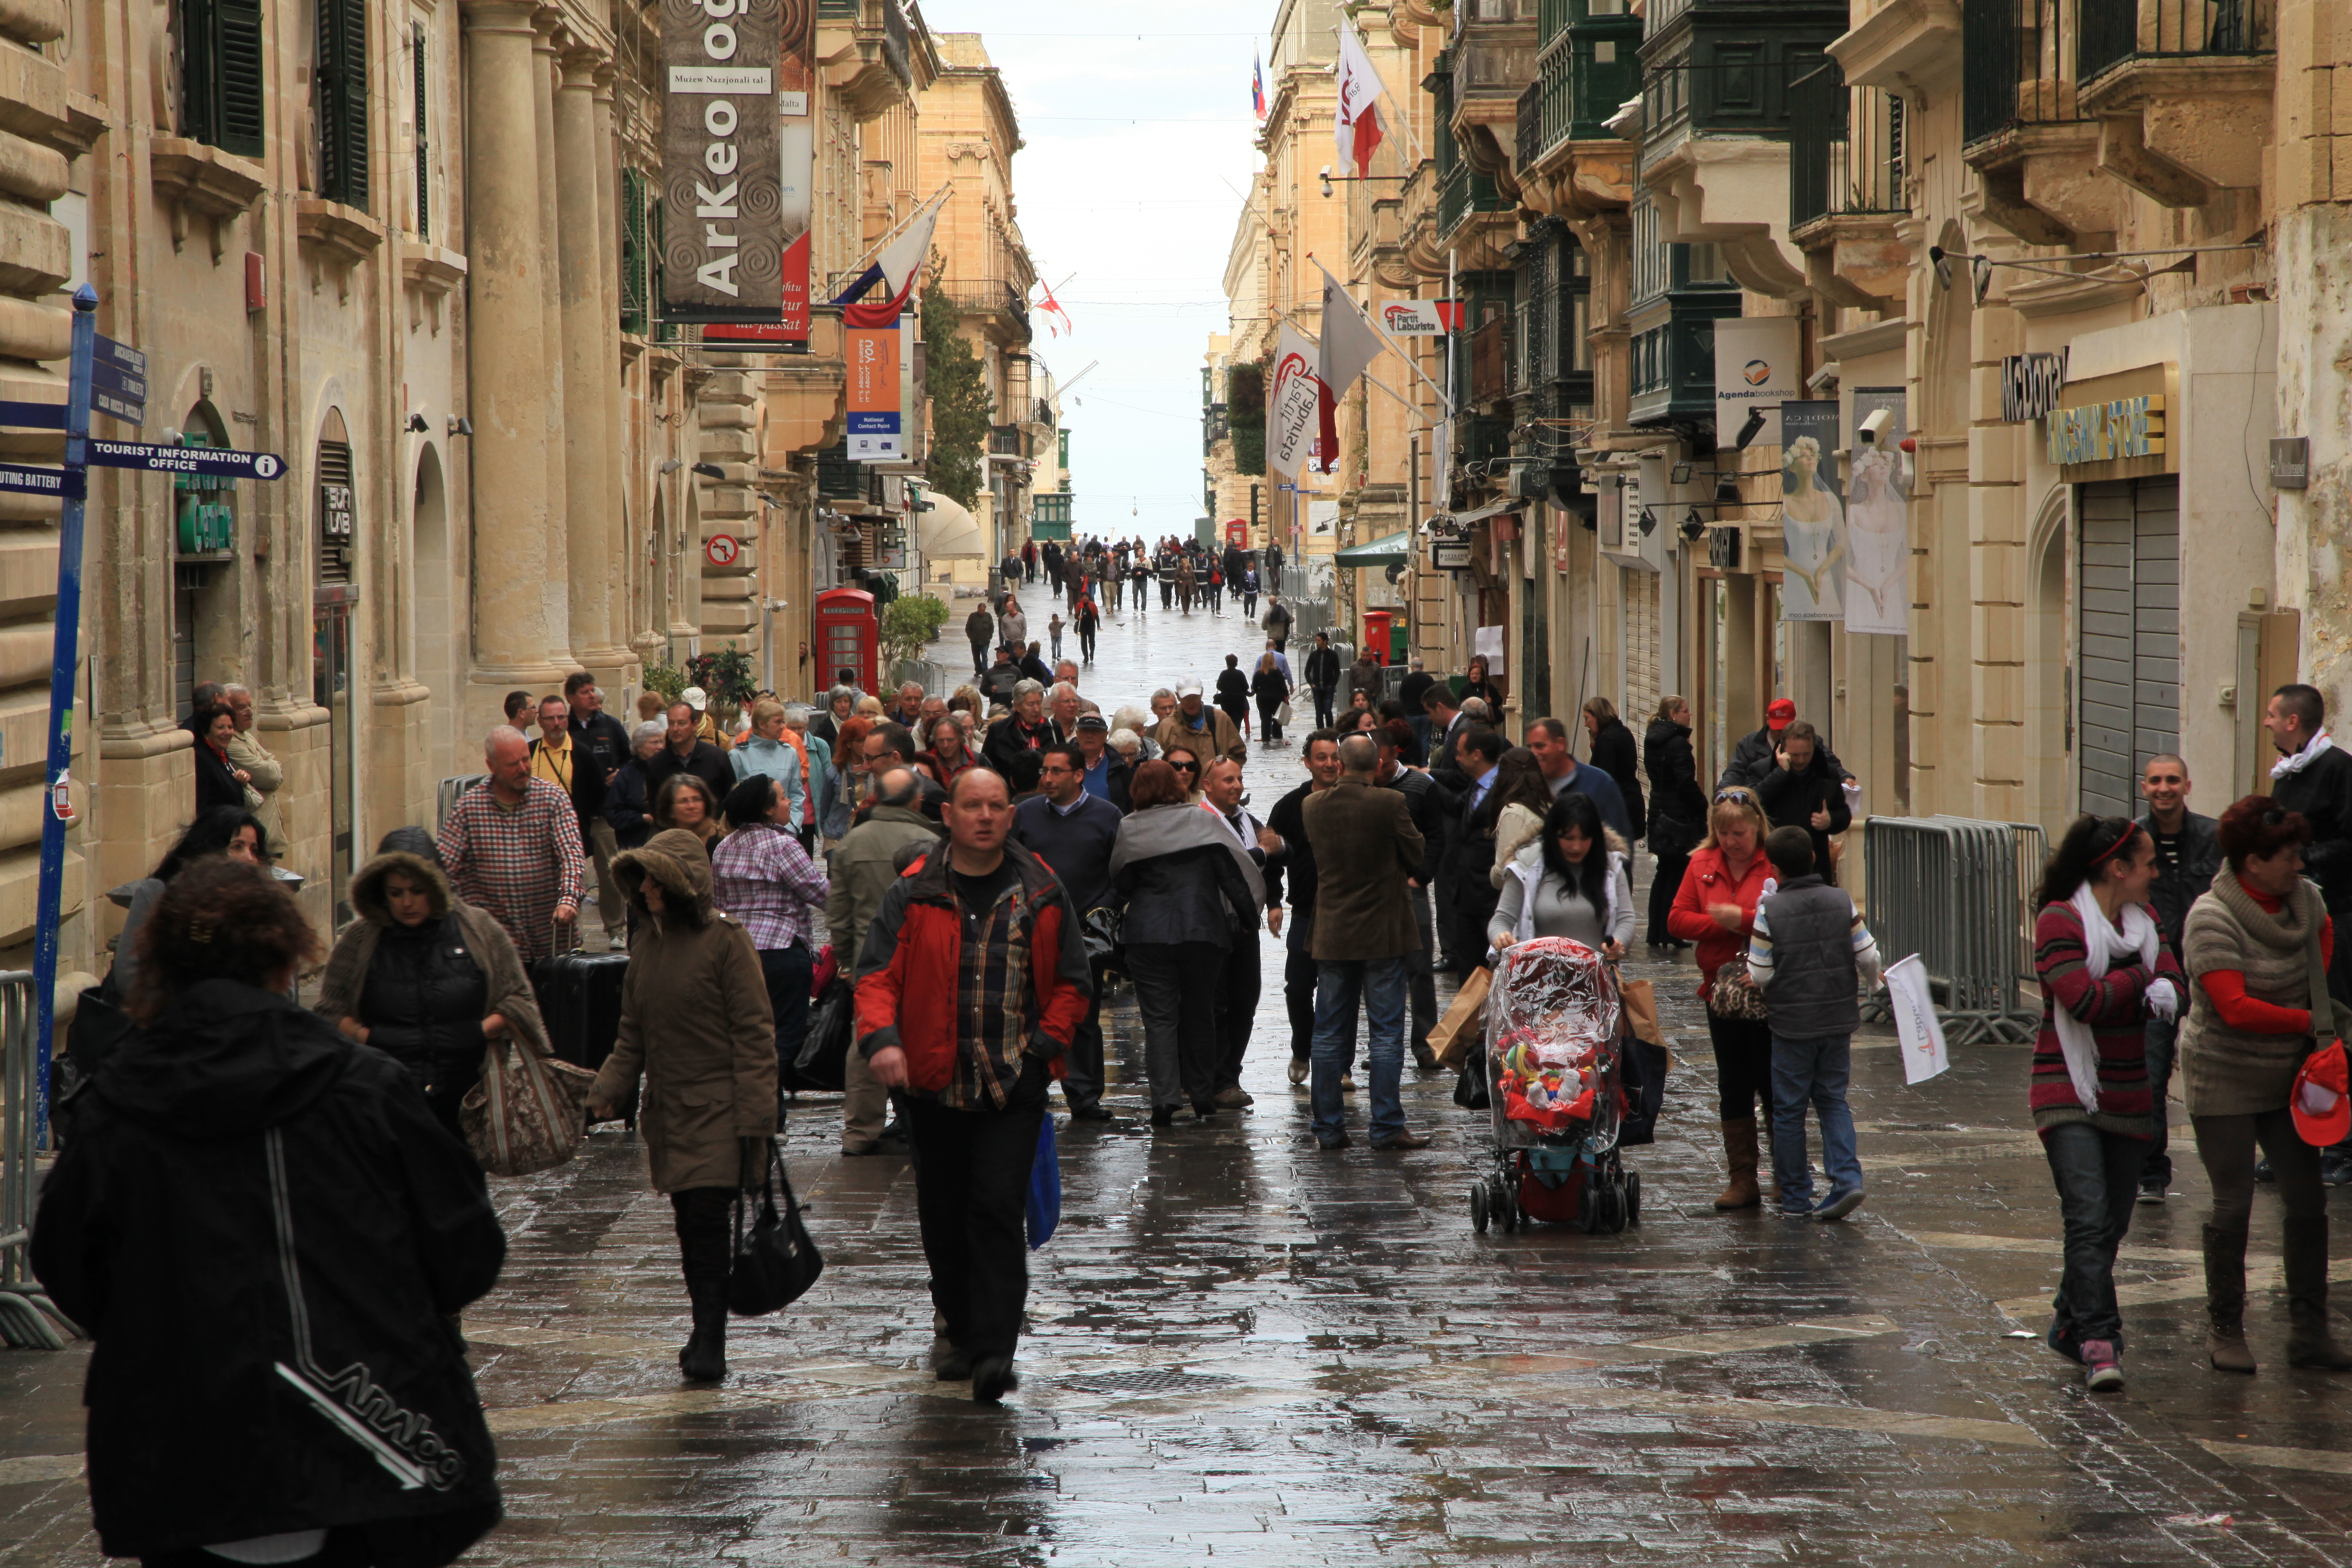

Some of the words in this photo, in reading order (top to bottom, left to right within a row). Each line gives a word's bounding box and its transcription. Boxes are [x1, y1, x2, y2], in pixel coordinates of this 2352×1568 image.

[706, 75, 750, 85] Nazzjonali
[1397, 314, 1418, 322] Partit
[1397, 322, 1435, 330] Laburista
[114, 344, 143, 367] ARCHAEOLOGY
[864, 339, 876, 364] YOU
[128, 379, 144, 397] TOILETS
[1718, 389, 1795, 400] Agendabookshop
[98, 393, 109, 409] CASA
[110, 397, 124, 415] ROCCA
[125, 403, 142, 421] PICCOLA
[2046, 404, 2103, 465] KINGSWAY
[2107, 395, 2159, 460] STORE
[94, 443, 154, 456] TOURIST
[157, 447, 251, 464] INFORMATION
[149, 458, 197, 470] OFFICE
[25, 473, 62, 489] BATTERY
[330, 511, 351, 534] LAB
